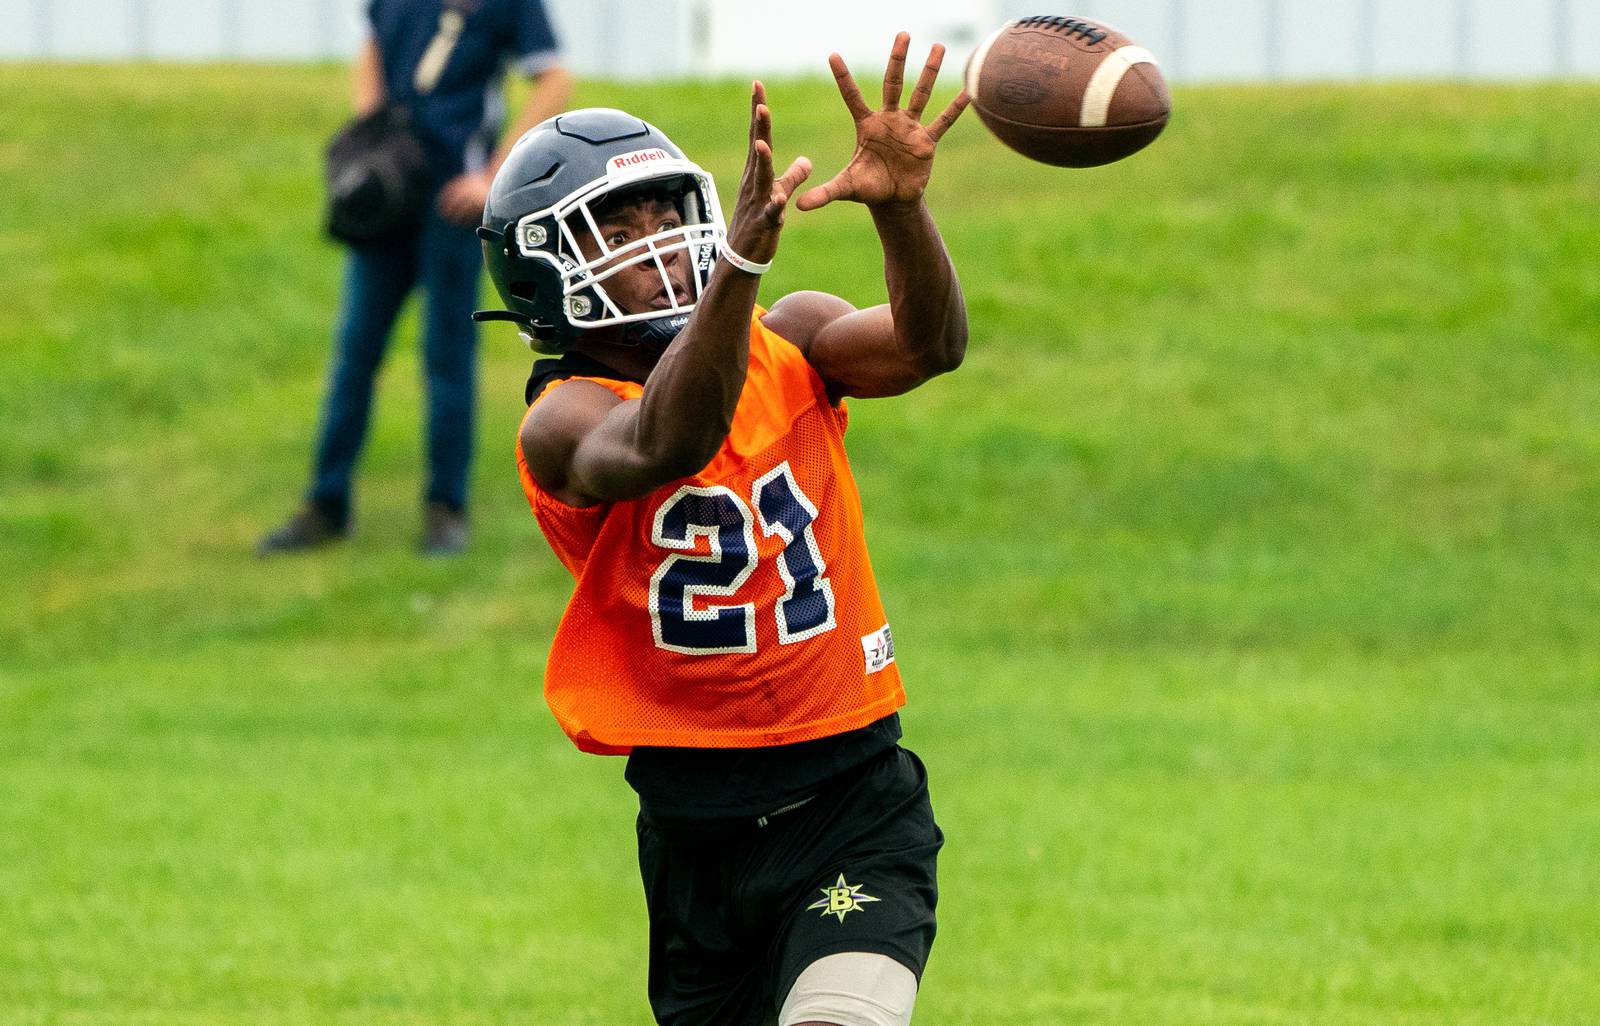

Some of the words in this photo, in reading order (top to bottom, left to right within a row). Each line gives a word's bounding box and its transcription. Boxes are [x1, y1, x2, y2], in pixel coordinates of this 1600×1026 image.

[613, 150, 665, 169] Riddell
[648, 460, 837, 656] 21
[829, 887, 854, 912] B
